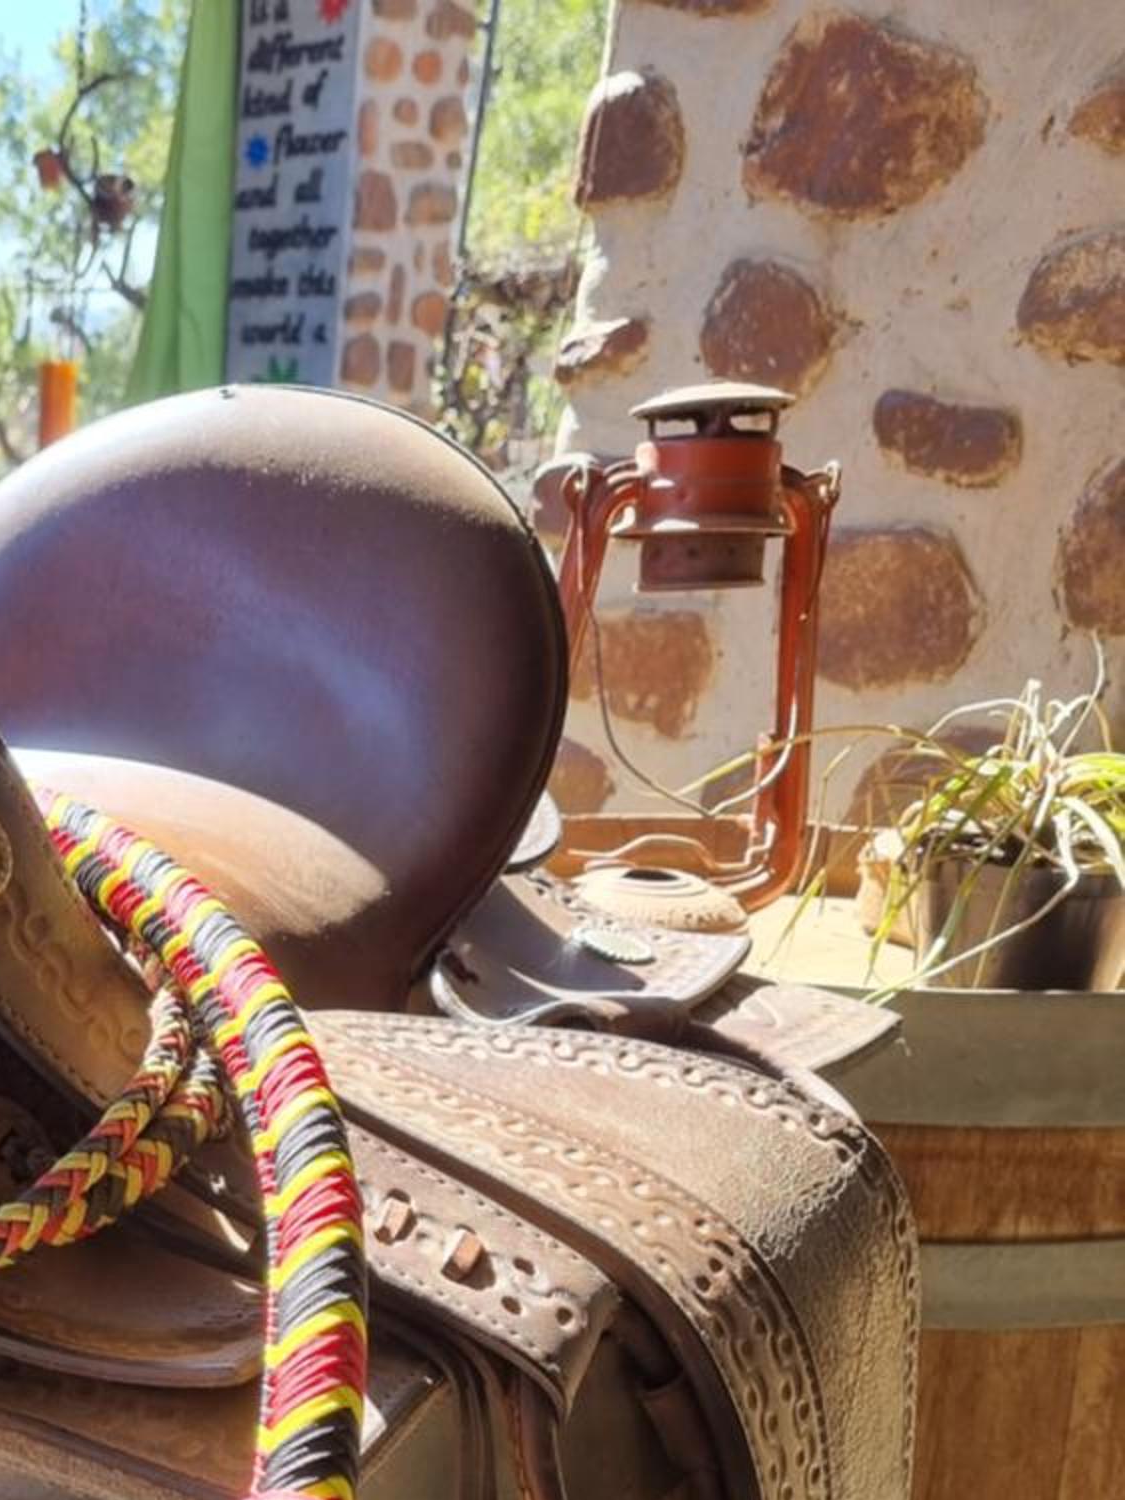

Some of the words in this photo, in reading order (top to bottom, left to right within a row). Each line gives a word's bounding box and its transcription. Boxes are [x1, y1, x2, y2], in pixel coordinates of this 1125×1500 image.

[247, 32, 345, 74] different
[242, 78, 293, 119] kind
[302, 68, 328, 111] of
[272, 122, 347, 166] flower
[233, 172, 279, 211] and
[294, 167, 323, 204] all
[248, 213, 339, 261] together
[297, 262, 336, 297] this
[241, 311, 306, 346] world
